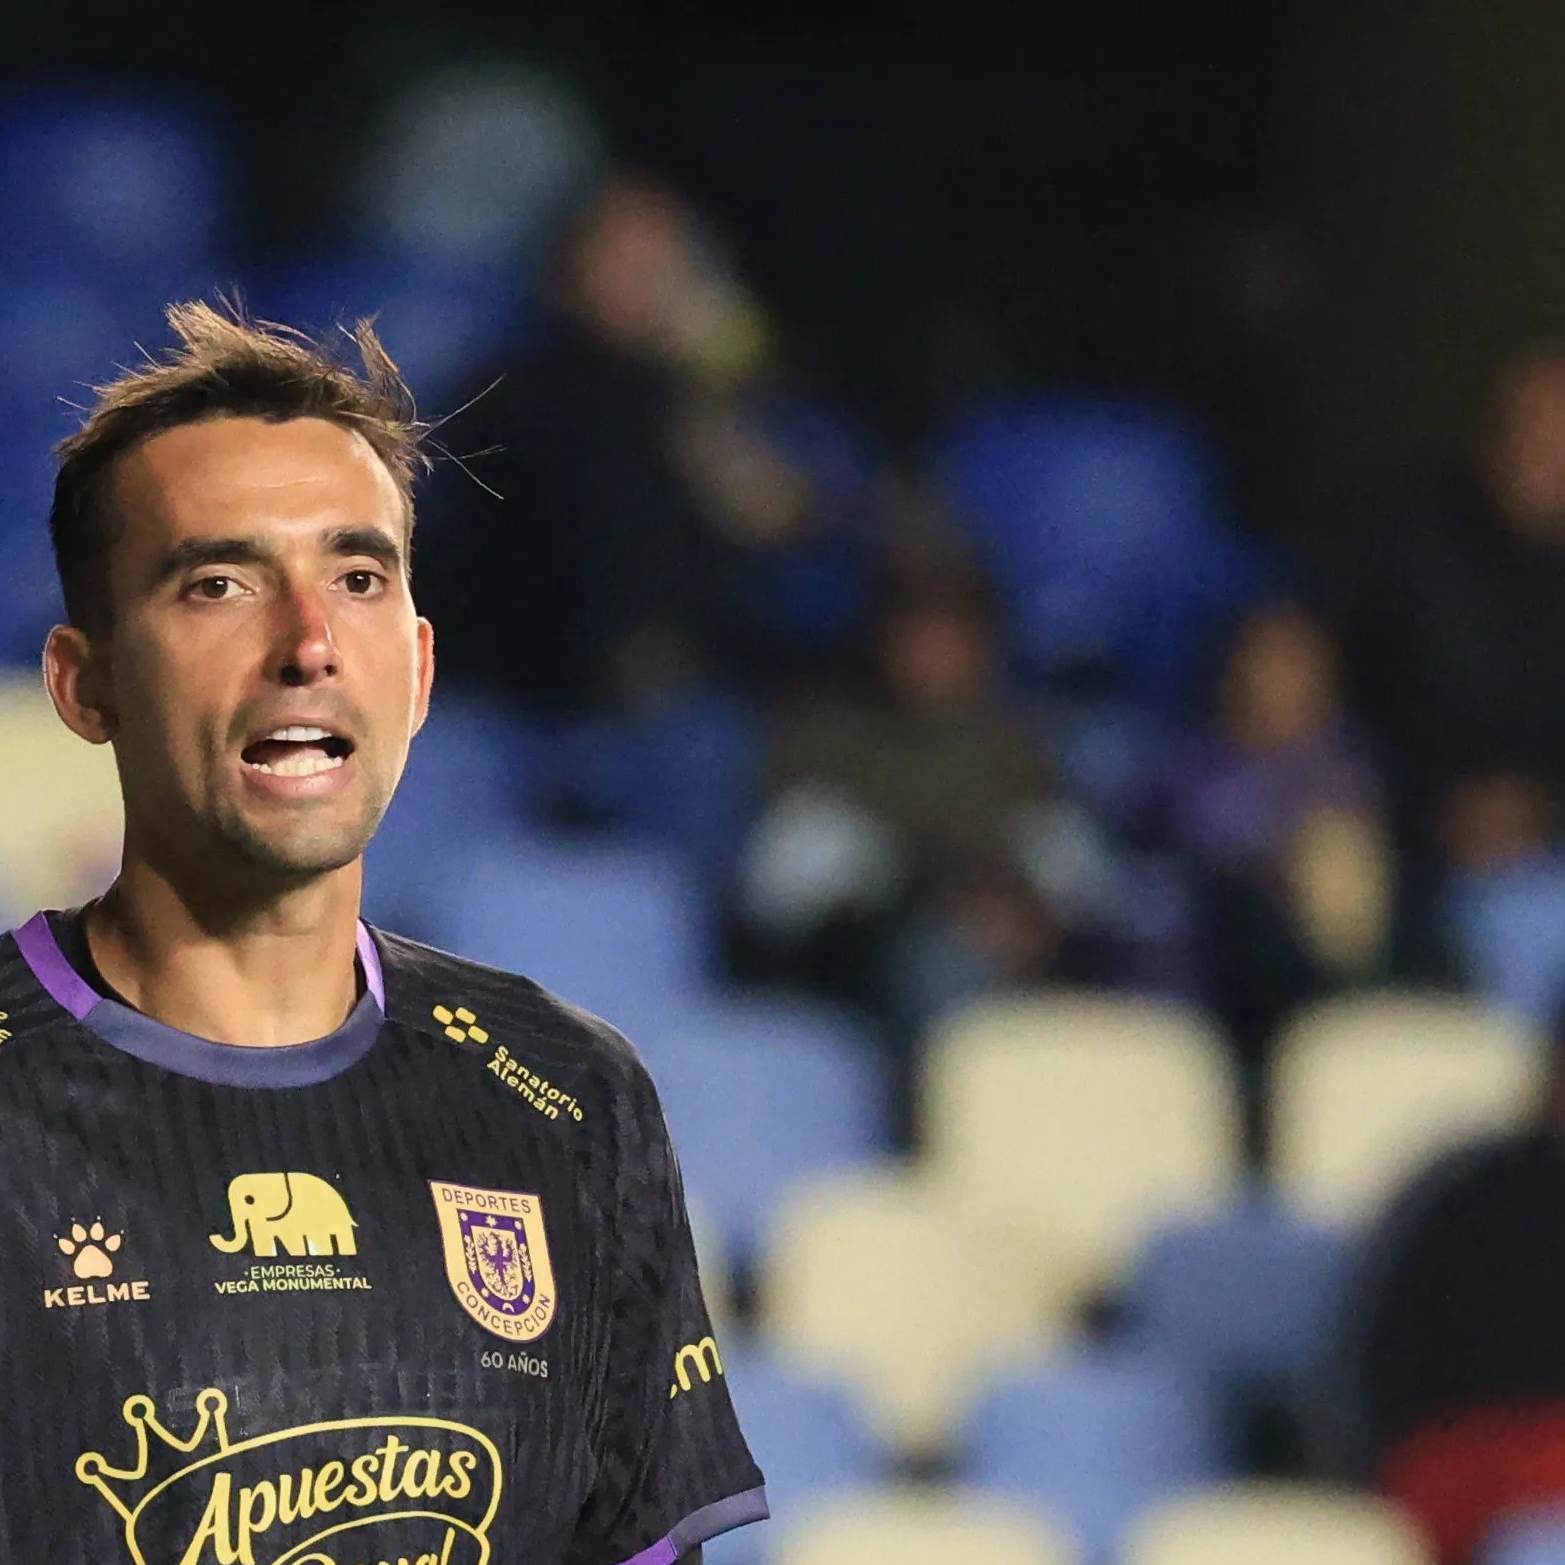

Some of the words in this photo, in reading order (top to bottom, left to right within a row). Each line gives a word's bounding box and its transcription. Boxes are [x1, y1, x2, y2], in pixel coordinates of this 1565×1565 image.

[486, 1059, 559, 1120] Alemán
[494, 1045, 583, 1122] Sanatorio
[441, 1187, 532, 1214] DEPORTES
[44, 1281, 150, 1308] KELME
[214, 1280, 260, 1294] VEGA
[263, 1277, 373, 1291] MONUMENTAL
[456, 1281, 551, 1336] CONCEPCION
[480, 1351, 504, 1369] 60
[507, 1351, 549, 1378] AÑOS
